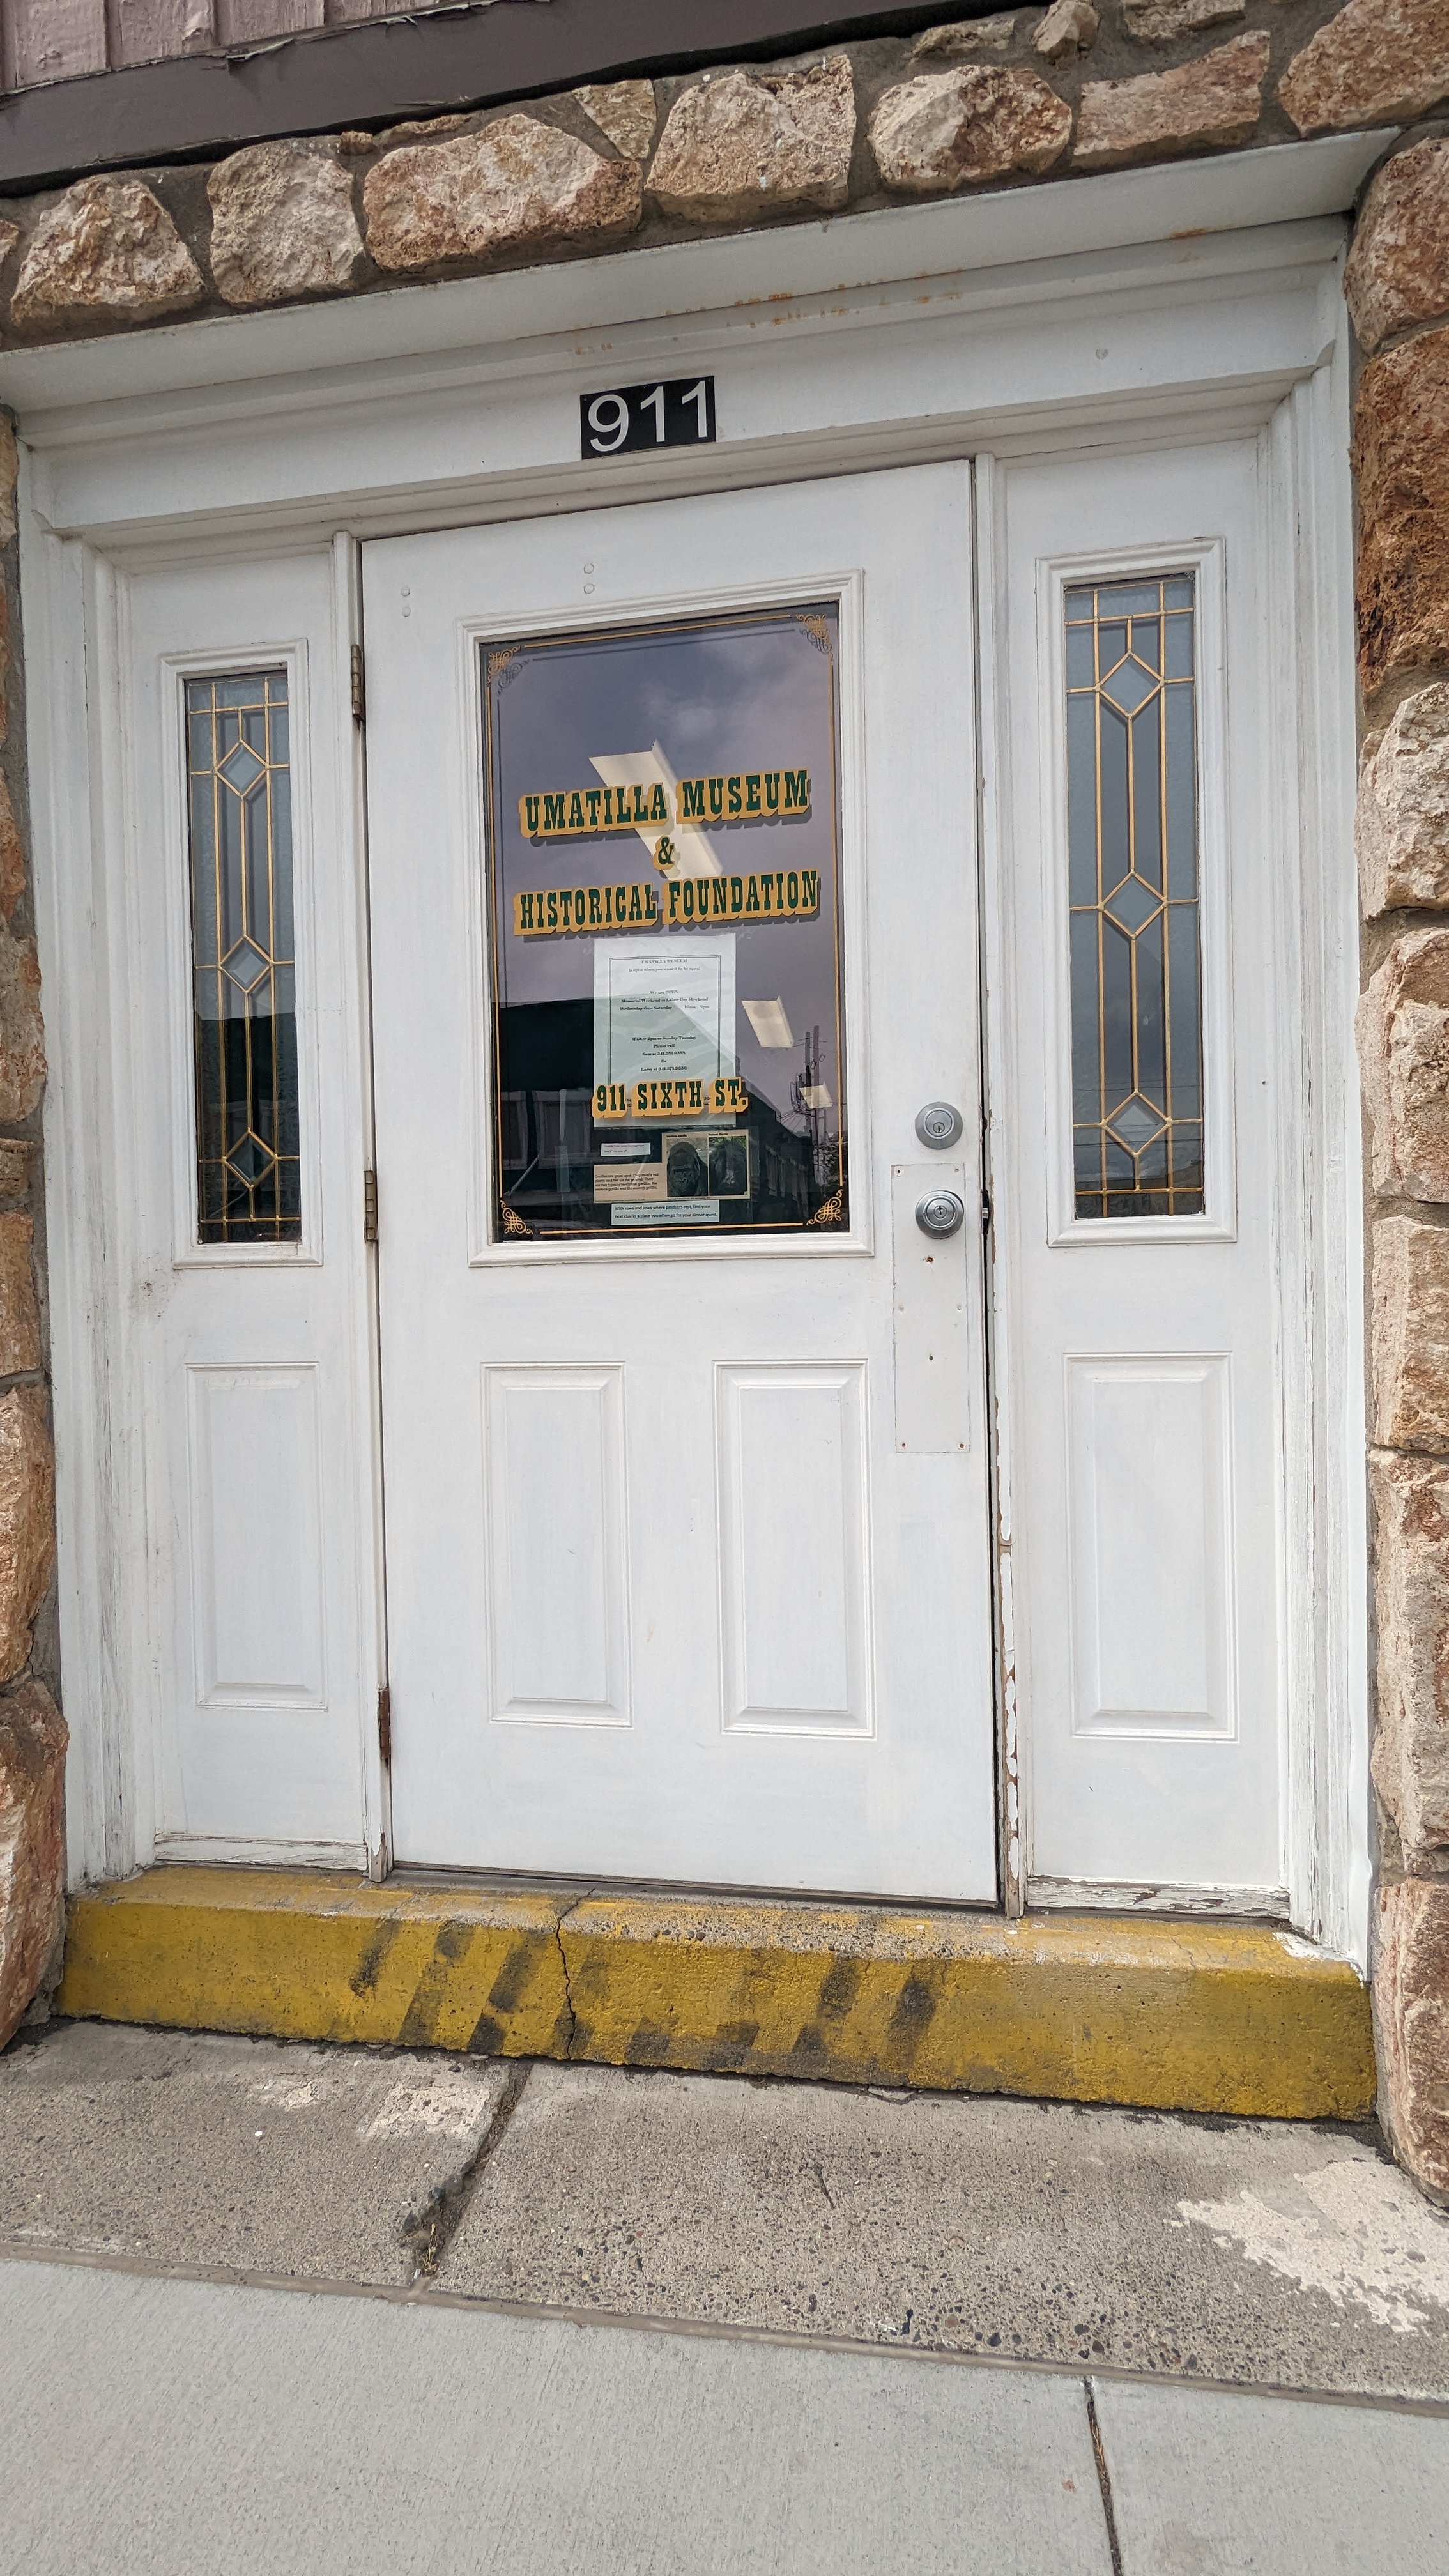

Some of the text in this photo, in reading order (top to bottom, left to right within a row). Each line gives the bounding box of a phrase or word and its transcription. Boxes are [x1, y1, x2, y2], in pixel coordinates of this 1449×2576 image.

[588, 380, 707, 452] 911
[521, 769, 809, 835] UMATILLA MUSEUM
[654, 836, 675, 868] &
[516, 870, 818, 933] HISTORICAL FOUNDATION
[594, 1077, 748, 1116] 911 SIXTH ST.
